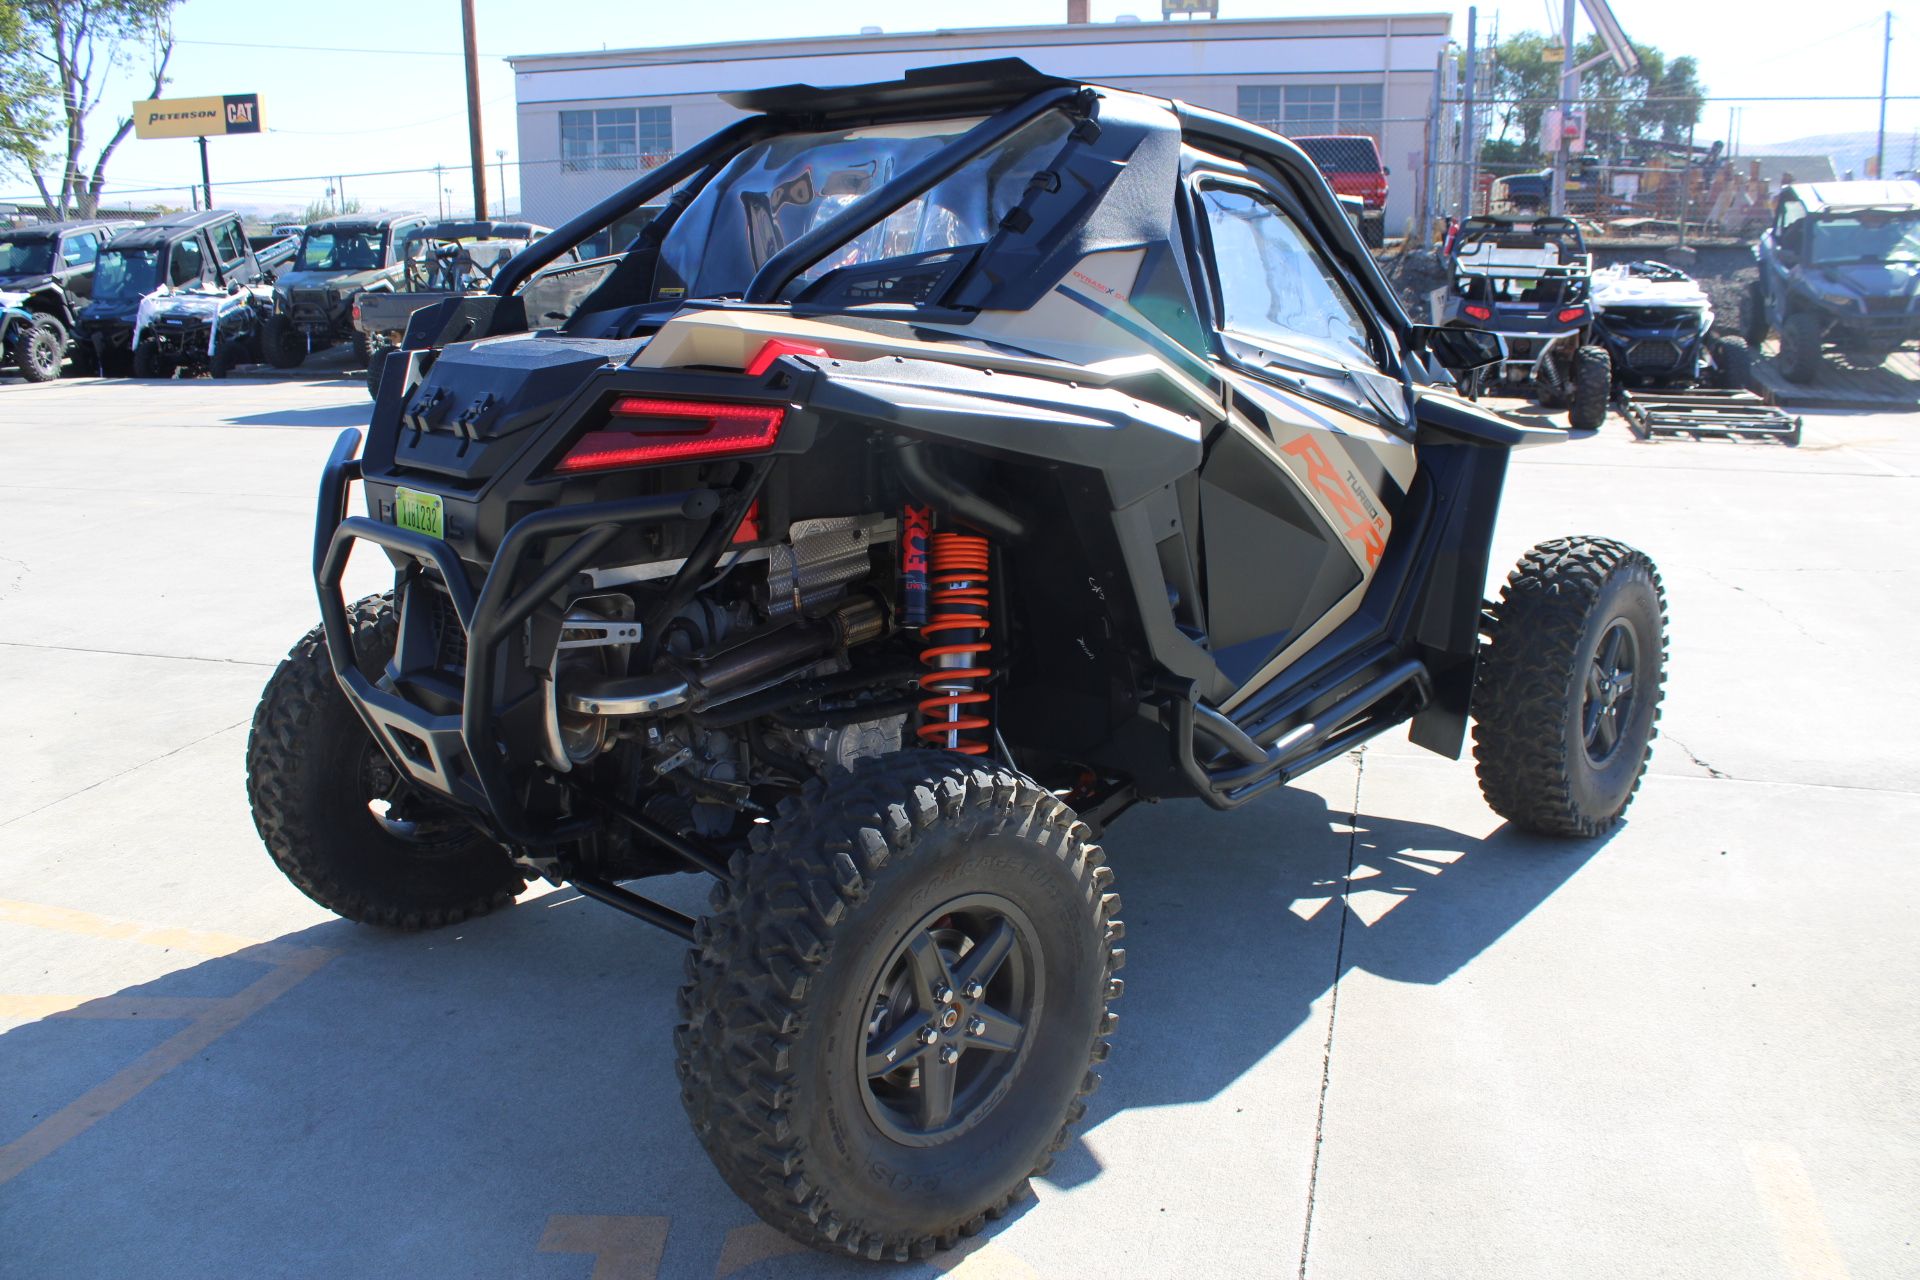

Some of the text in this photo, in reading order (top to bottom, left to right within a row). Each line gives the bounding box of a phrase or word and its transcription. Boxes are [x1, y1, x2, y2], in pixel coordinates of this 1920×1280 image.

[149, 110, 217, 125] PETERSON
[226, 103, 253, 123] CAT
[1280, 433, 1385, 569] RZR
[1346, 470, 1385, 531] TURBO R
[902, 504, 929, 574] FOX
